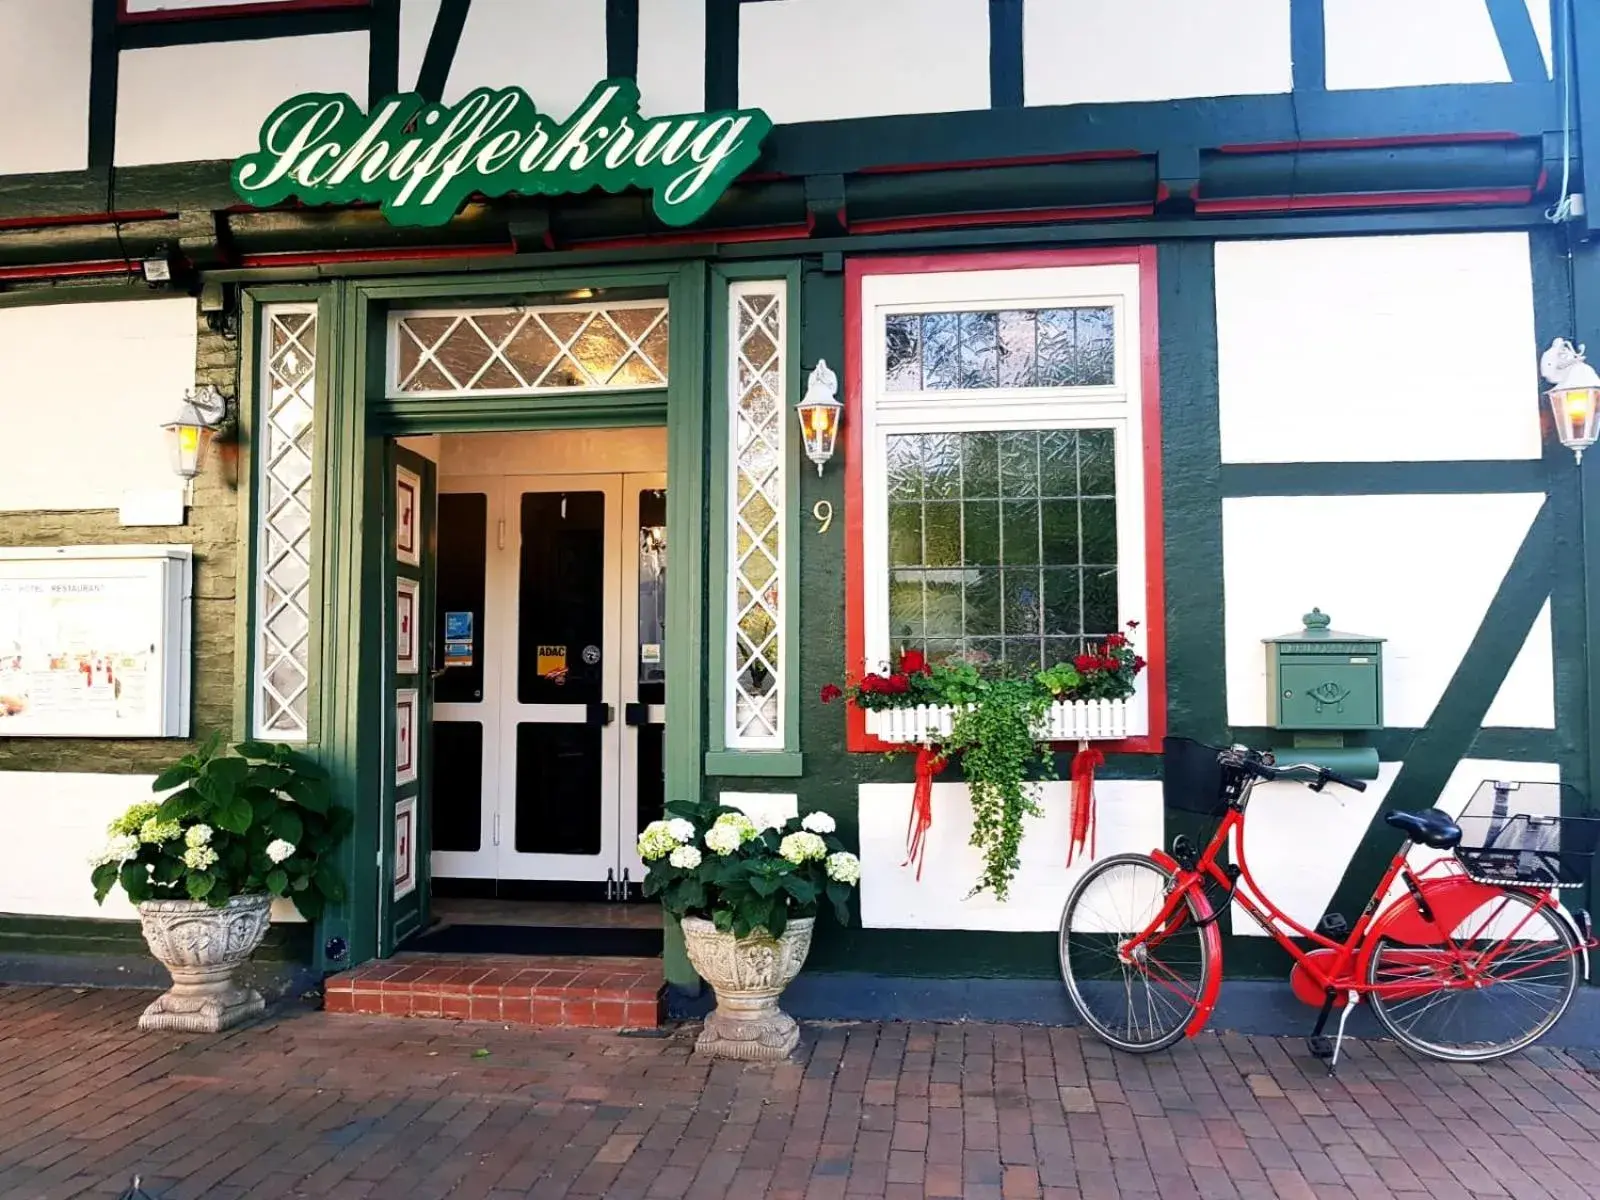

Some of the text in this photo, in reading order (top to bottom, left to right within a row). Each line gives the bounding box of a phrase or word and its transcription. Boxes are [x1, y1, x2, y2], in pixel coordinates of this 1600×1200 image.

[239, 86, 752, 205] Schifferkrug
[813, 500, 833, 534] 9
[51, 583, 105, 593] RESTAURANT
[538, 647, 565, 657] ADAC
